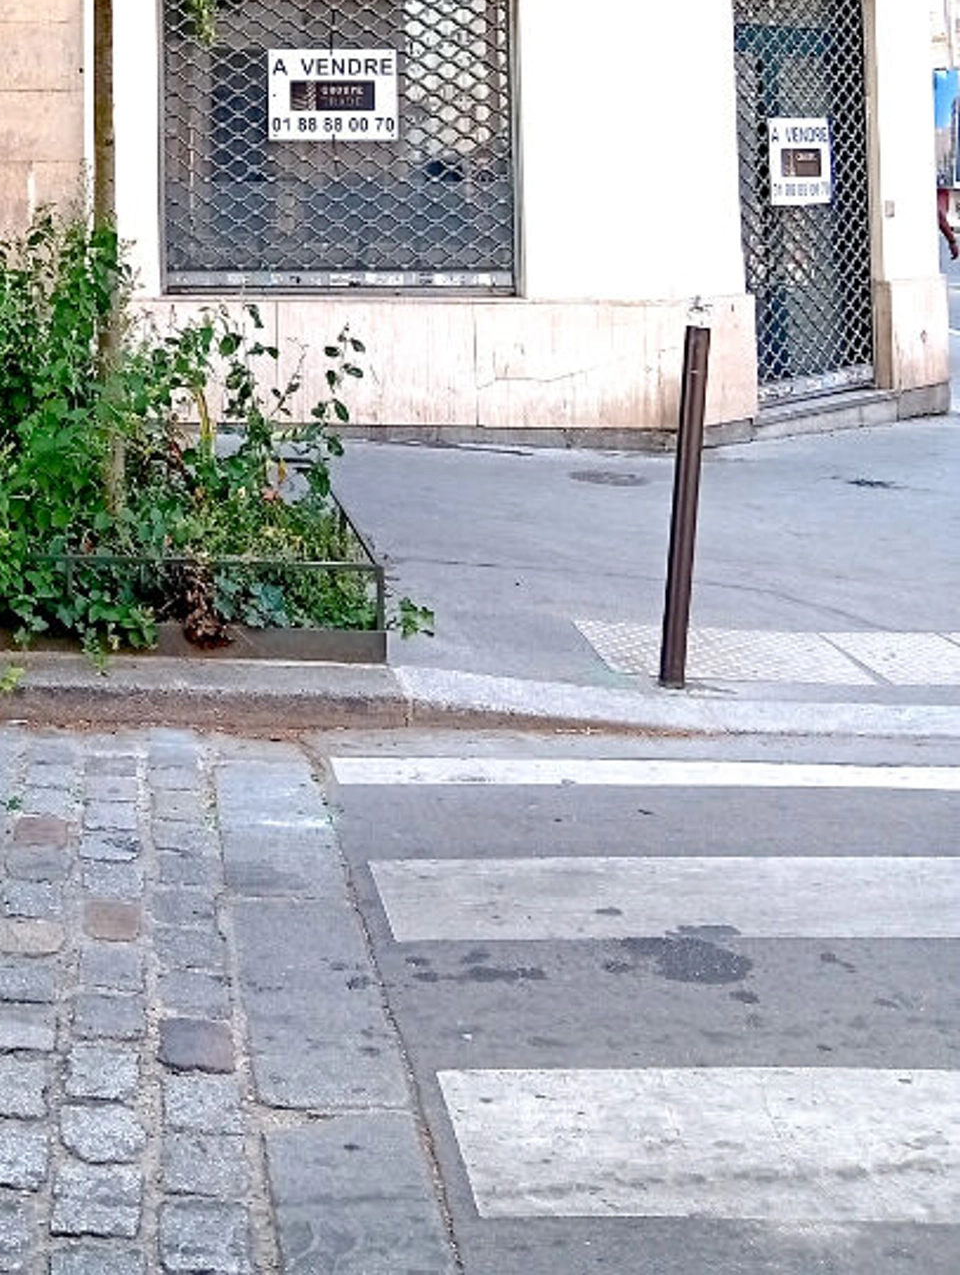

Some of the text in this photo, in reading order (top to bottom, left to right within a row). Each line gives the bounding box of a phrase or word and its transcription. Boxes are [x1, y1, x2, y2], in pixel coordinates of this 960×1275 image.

[272, 58, 393, 75] A VENDRE
[272, 117, 291, 133] 01
[298, 117, 317, 133] 88
[348, 117, 369, 133] 00
[375, 117, 395, 133] 70
